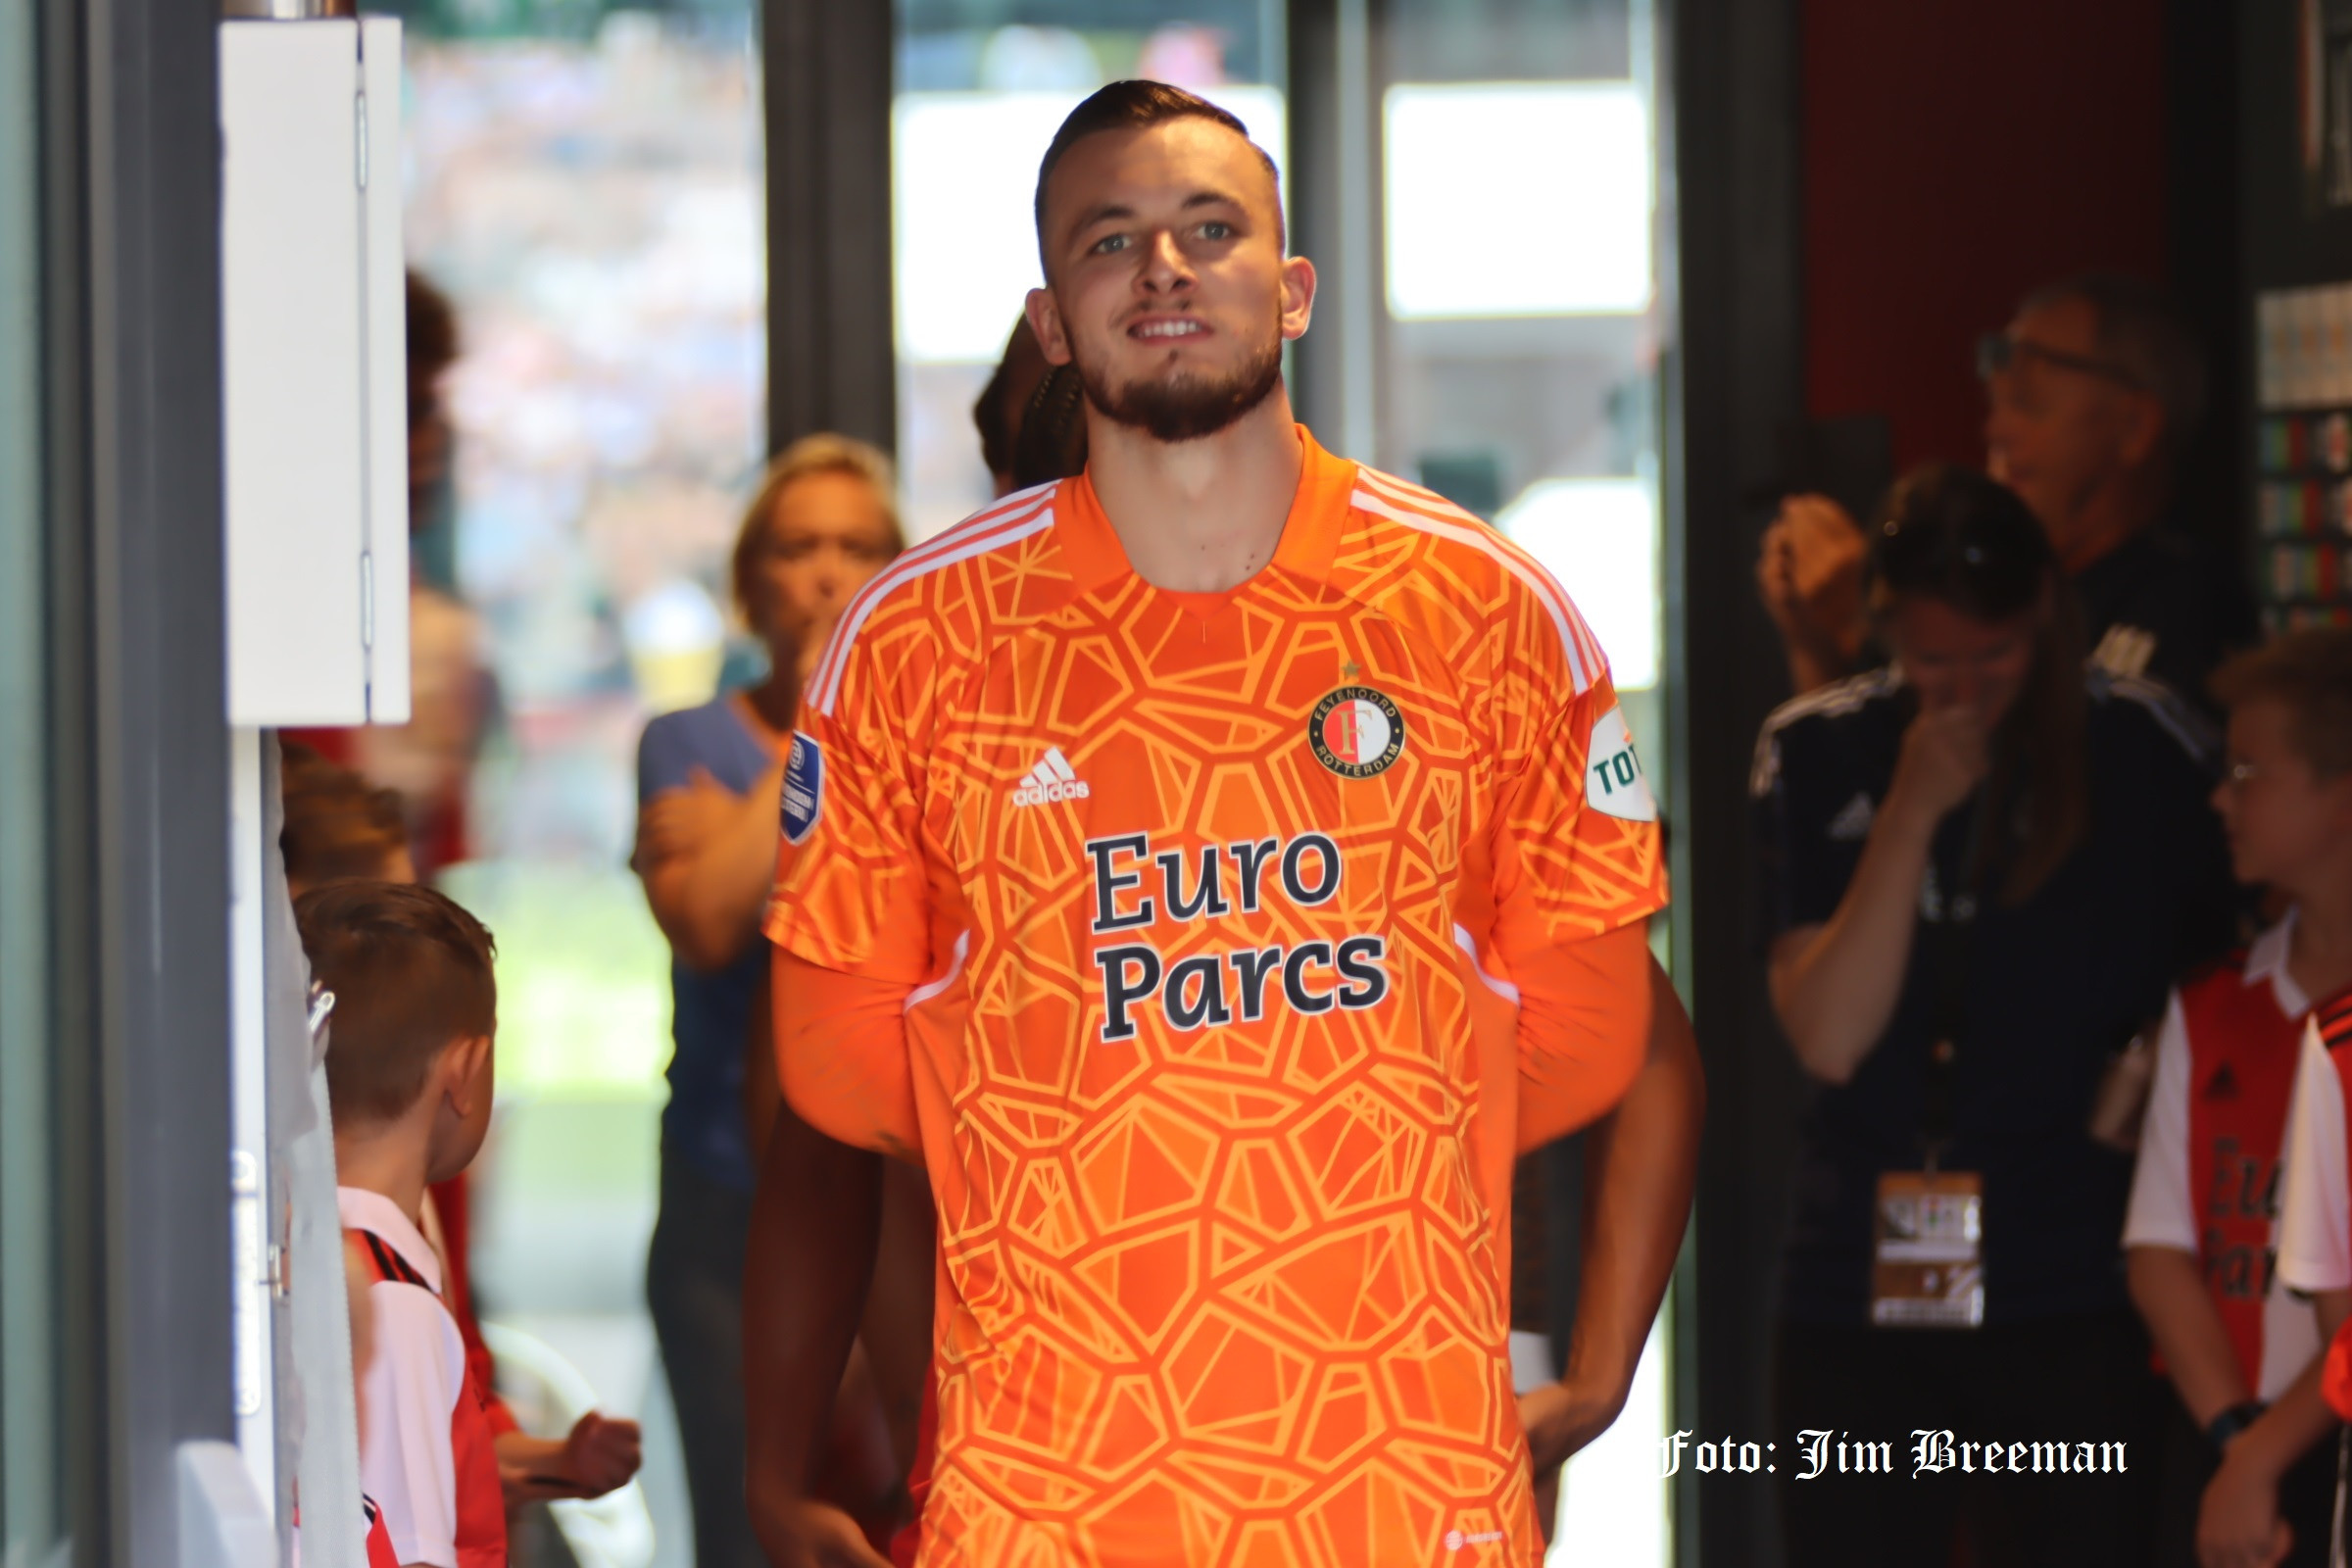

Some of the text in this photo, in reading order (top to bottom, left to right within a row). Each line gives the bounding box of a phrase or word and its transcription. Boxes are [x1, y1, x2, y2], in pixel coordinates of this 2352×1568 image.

[1314, 689, 1396, 721] FEYENOORD
[1317, 743, 1399, 776] ROTTERDAM
[1013, 780, 1090, 807] adidas
[1086, 830, 1342, 935] Euro
[1094, 933, 1390, 1044] Parcs
